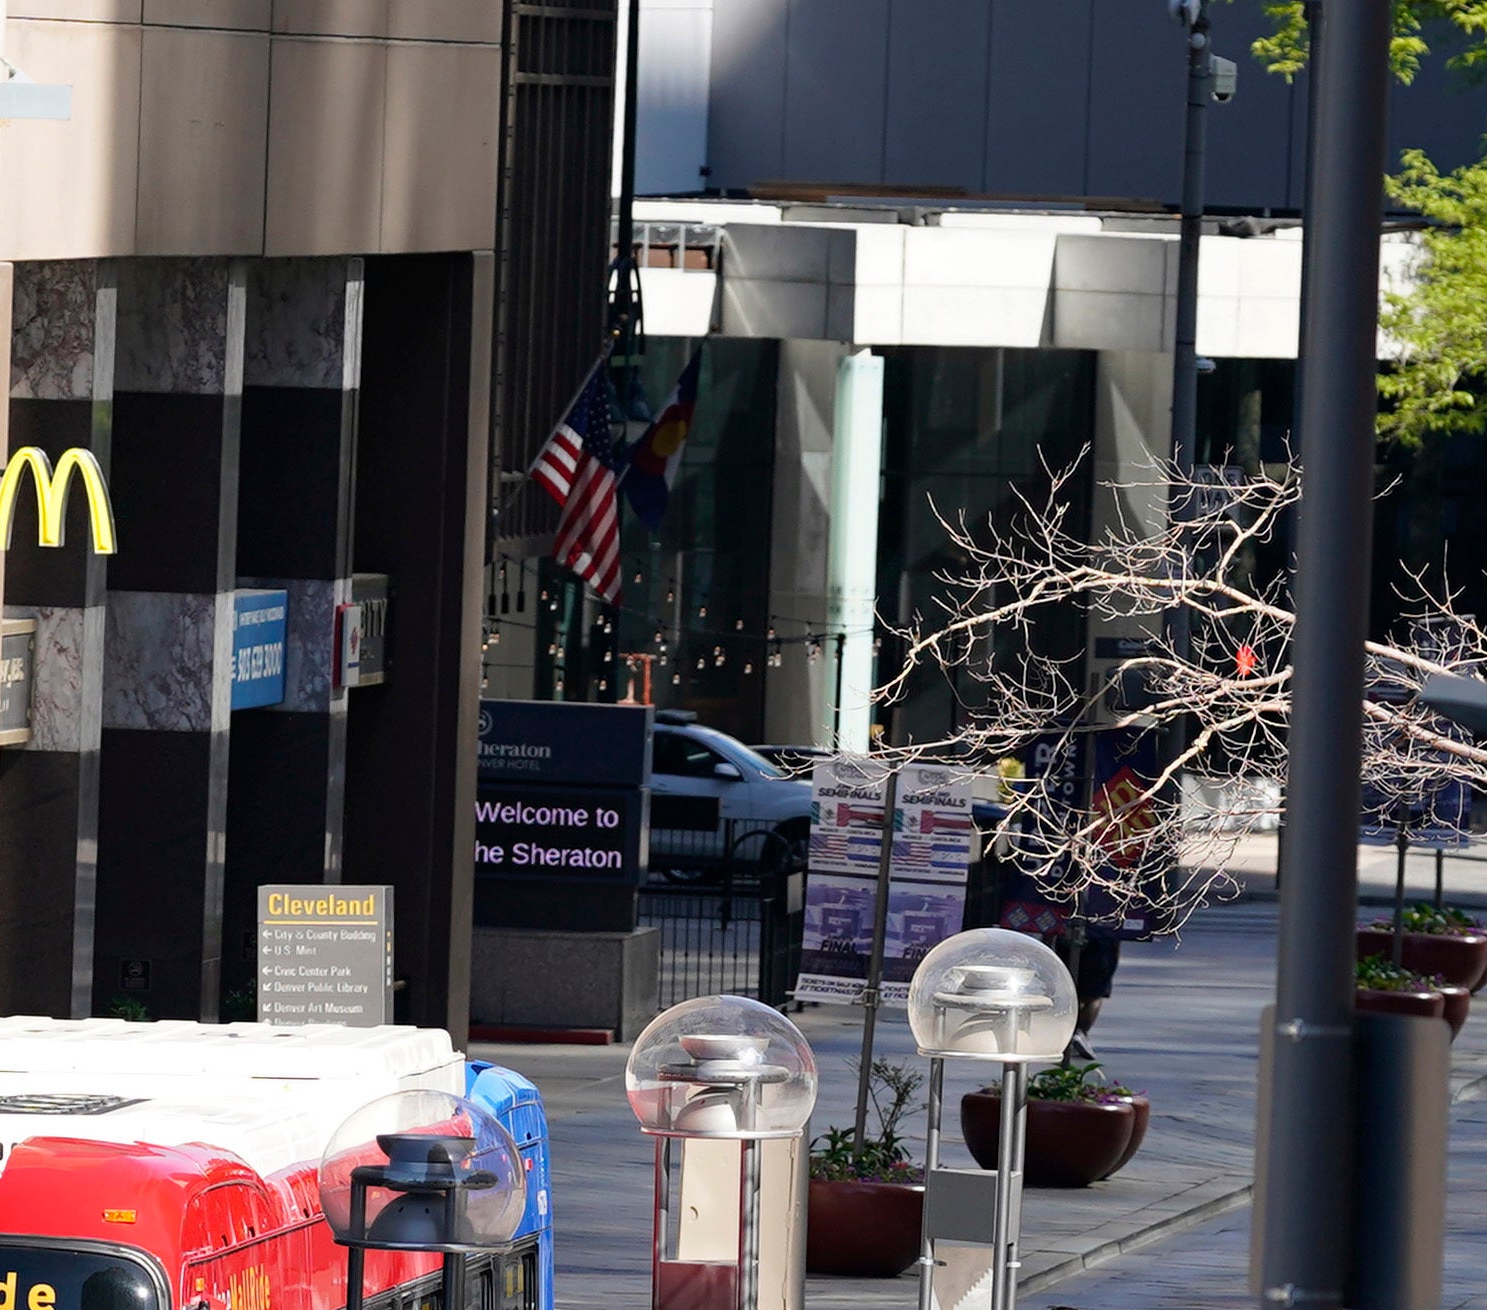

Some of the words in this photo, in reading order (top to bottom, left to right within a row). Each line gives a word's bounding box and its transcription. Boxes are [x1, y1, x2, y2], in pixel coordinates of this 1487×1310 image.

[478, 741, 551, 758] heraton
[479, 758, 506, 769] NVER
[507, 760, 540, 770] HOTEL
[818, 788, 881, 801] SEMIFINALS
[902, 794, 966, 808] SEMIFINALS
[475, 801, 589, 826] Welcome
[596, 807, 619, 828] to
[475, 840, 504, 864] he
[512, 842, 622, 868] Sheraton
[268, 893, 375, 916] Cleveland
[274, 929, 292, 941] City
[294, 930, 304, 940] &
[306, 929, 338, 941] County
[340, 929, 376, 943] Building
[296, 945, 317, 956] Mint
[820, 939, 857, 953] FINAL
[274, 965, 296, 977] Civic
[298, 965, 328, 977] Center
[330, 966, 352, 977] Park
[274, 982, 305, 992] Denver
[307, 982, 333, 993] Public
[337, 982, 368, 994] Library
[274, 1002, 305, 1013] Denver
[308, 1003, 323, 1013] Art
[325, 1003, 363, 1014] Museum
